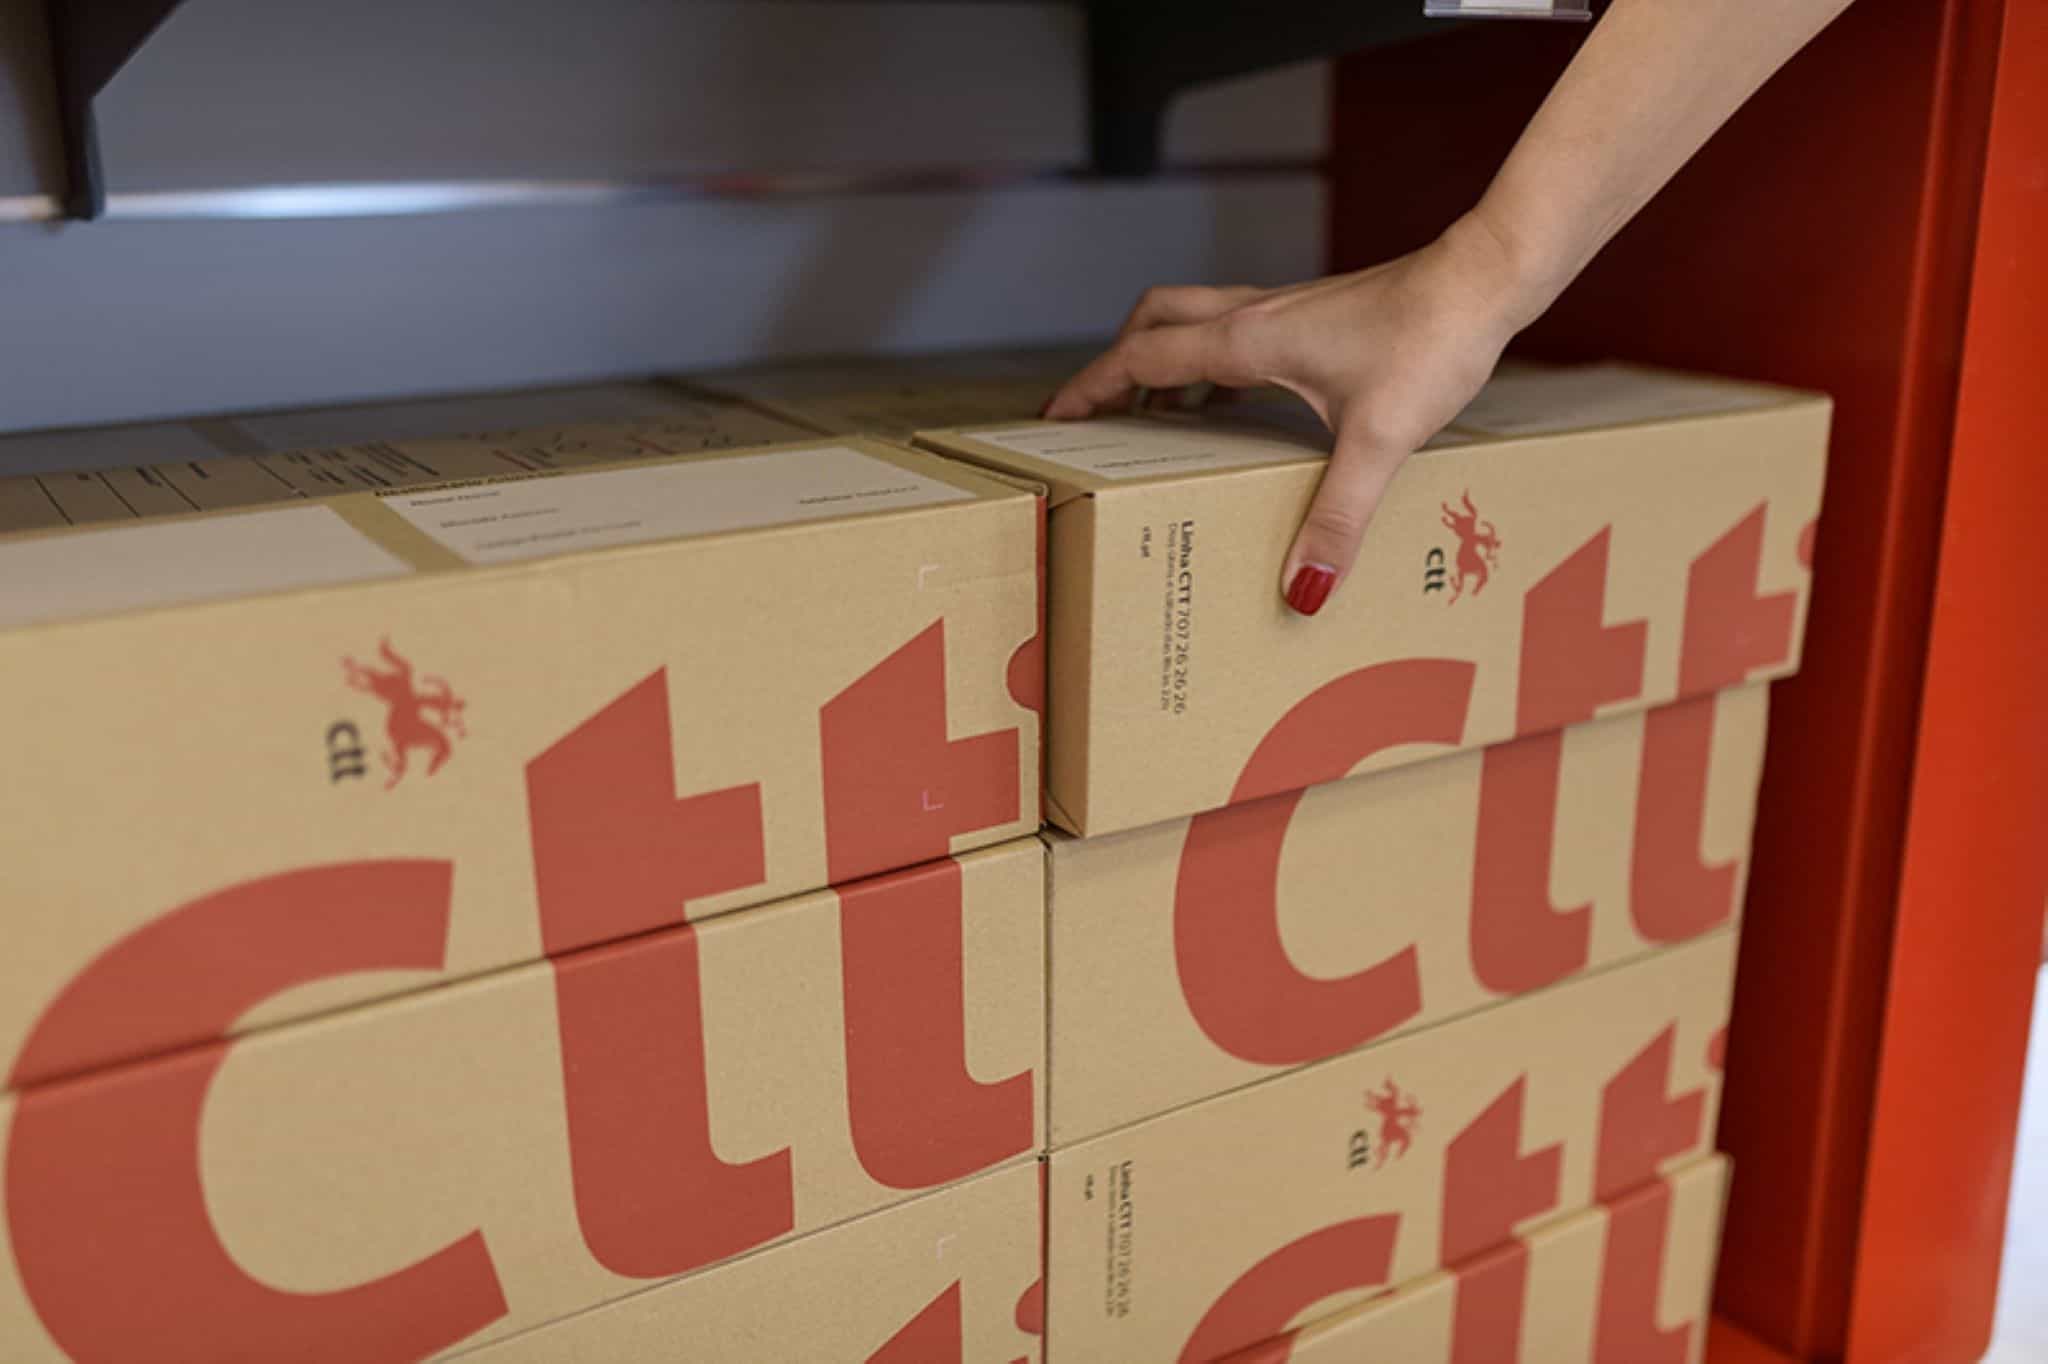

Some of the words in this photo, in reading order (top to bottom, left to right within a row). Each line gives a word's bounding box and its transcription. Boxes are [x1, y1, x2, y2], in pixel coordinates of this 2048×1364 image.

[1180, 520, 1194, 568] Linha
[1178, 571, 1192, 603] CTT
[1424, 547, 1447, 594] ctt
[1176, 607, 1191, 639] 707
[1175, 643, 1189, 665] 26
[1174, 667, 1187, 690] 26
[1173, 692, 1187, 714] 26
[326, 718, 366, 784] ctt
[1173, 500, 1798, 1066] ctt
[6, 617, 1034, 1364] ctt
[1347, 1129, 1370, 1170] ctt
